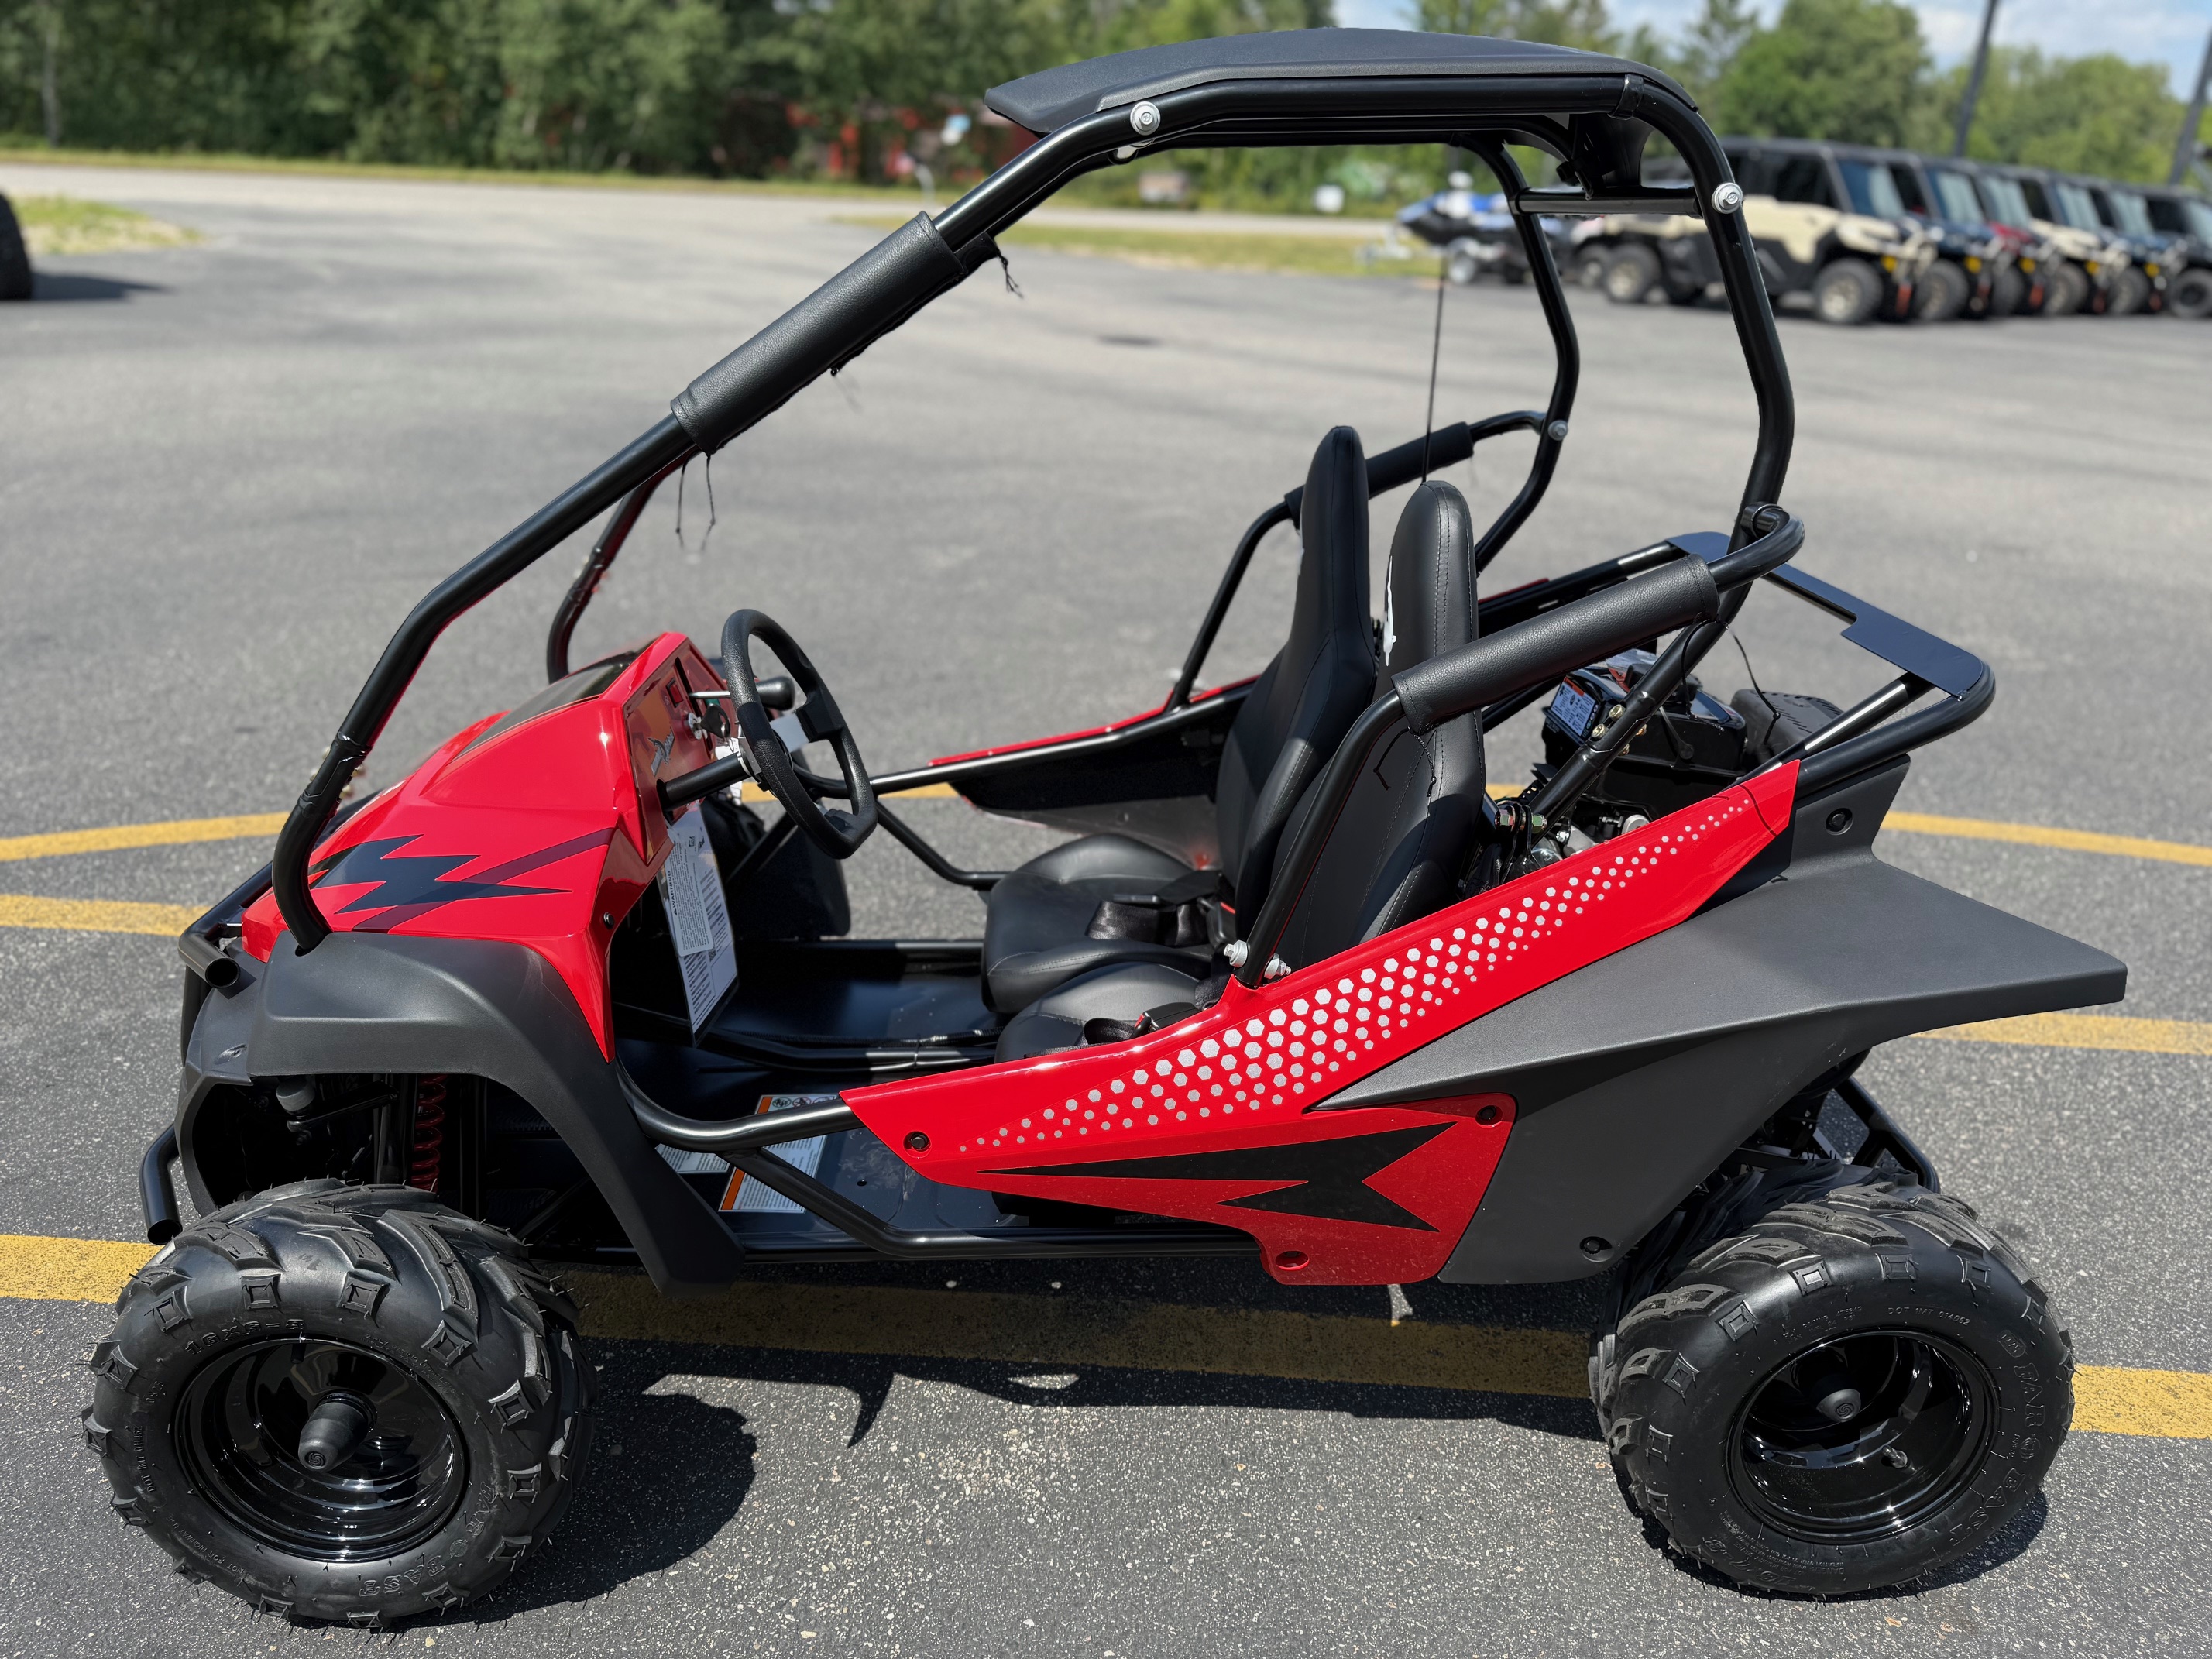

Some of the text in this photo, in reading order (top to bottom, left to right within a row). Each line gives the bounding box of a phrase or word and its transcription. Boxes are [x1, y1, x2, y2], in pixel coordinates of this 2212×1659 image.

[668, 870, 676, 908] WARNING
[1887, 1307, 1910, 1315] DOT
[2014, 1362, 2045, 1427] FAR
[140, 1475, 156, 1492] DOT
[1949, 1468, 2026, 1547] EAST
[178, 1528, 208, 1553] HIGHWAY
[359, 1481, 496, 1596] FAR EAST
[208, 1551, 226, 1565] FOR
[226, 1563, 246, 1574] NOT
